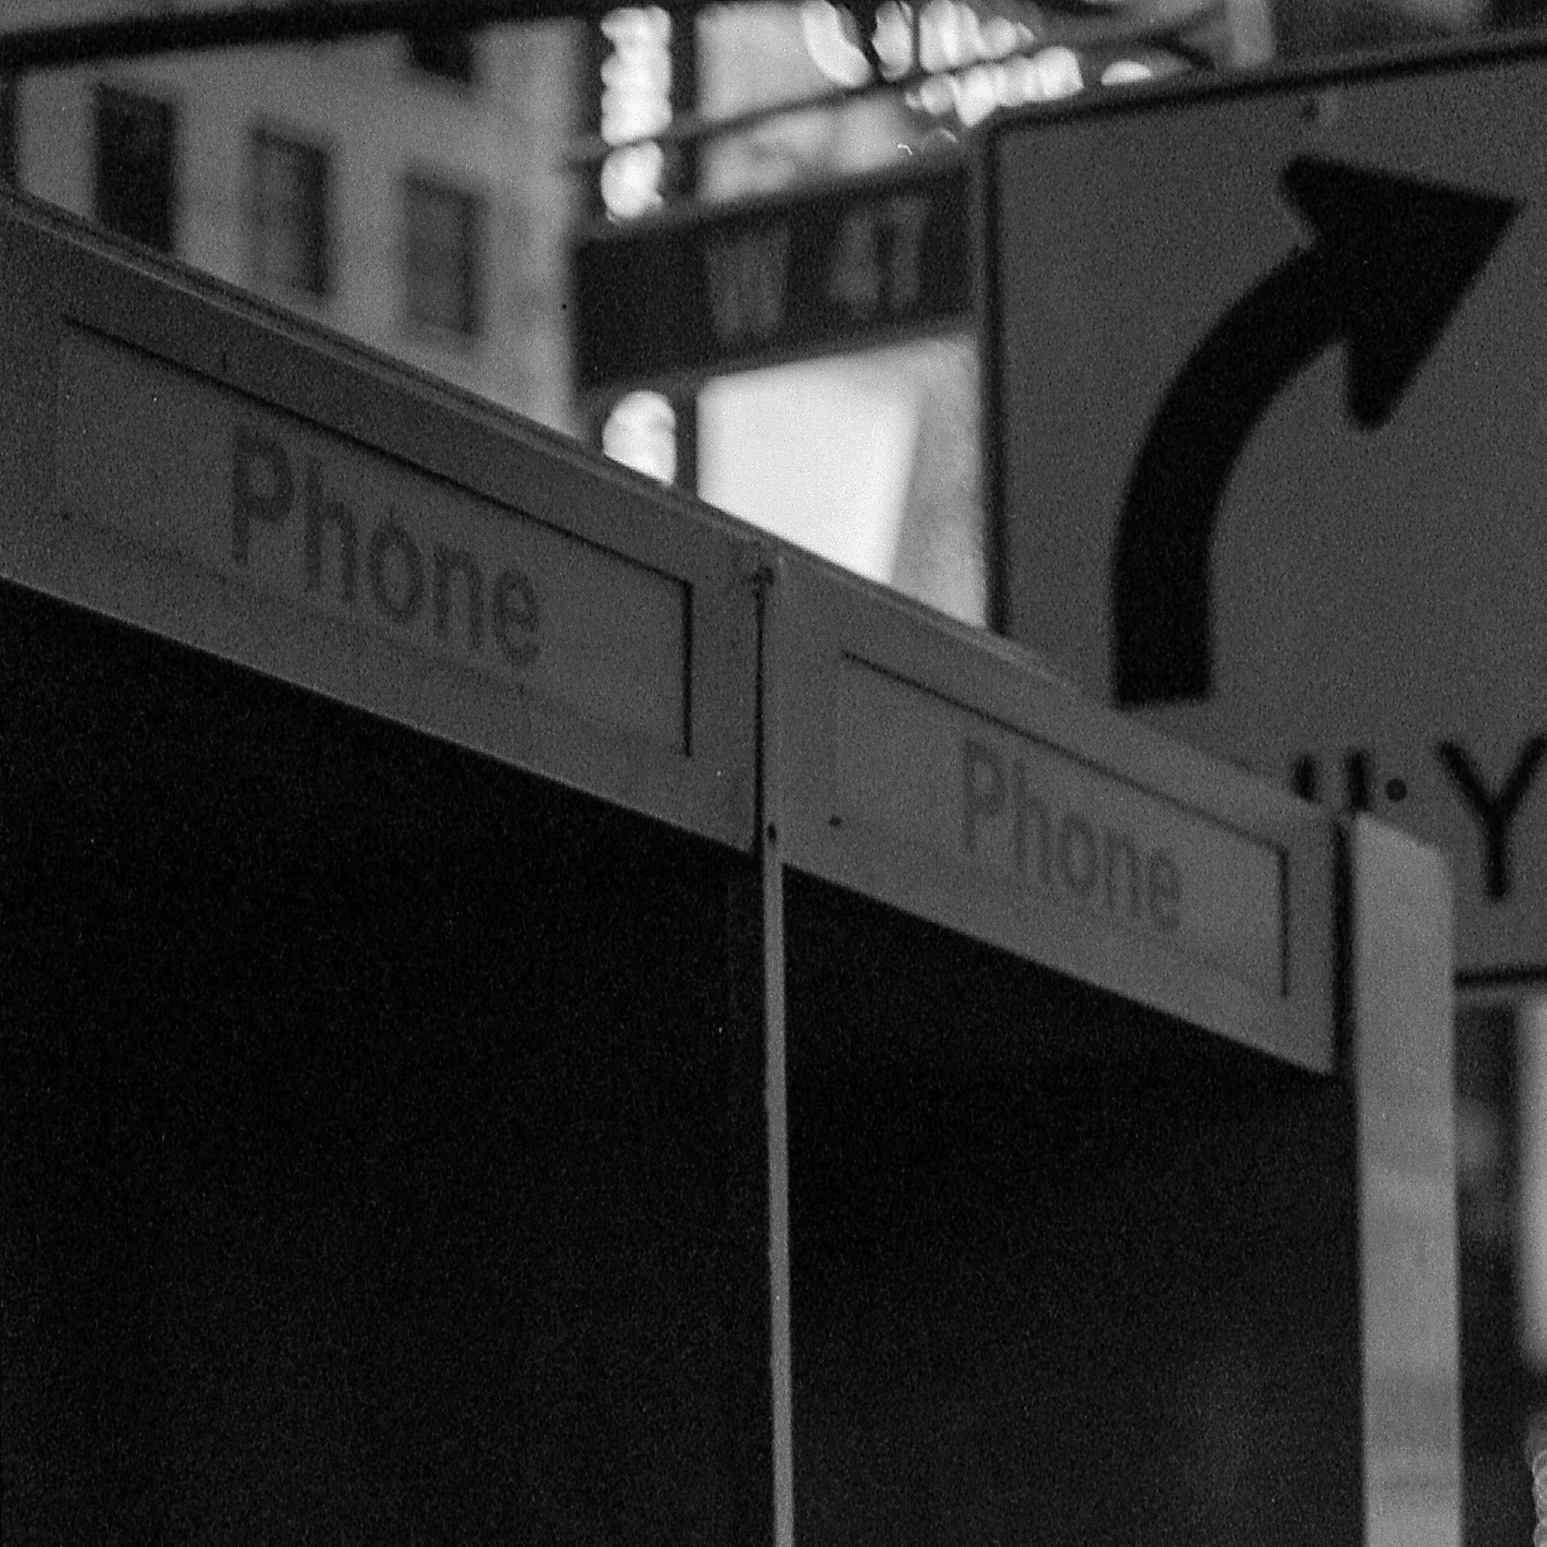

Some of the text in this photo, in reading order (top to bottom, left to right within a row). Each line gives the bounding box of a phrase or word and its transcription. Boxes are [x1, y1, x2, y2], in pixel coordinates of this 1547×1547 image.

[703, 221, 791, 347] W
[231, 423, 541, 667] Phone
[963, 737, 1182, 933] Phone
